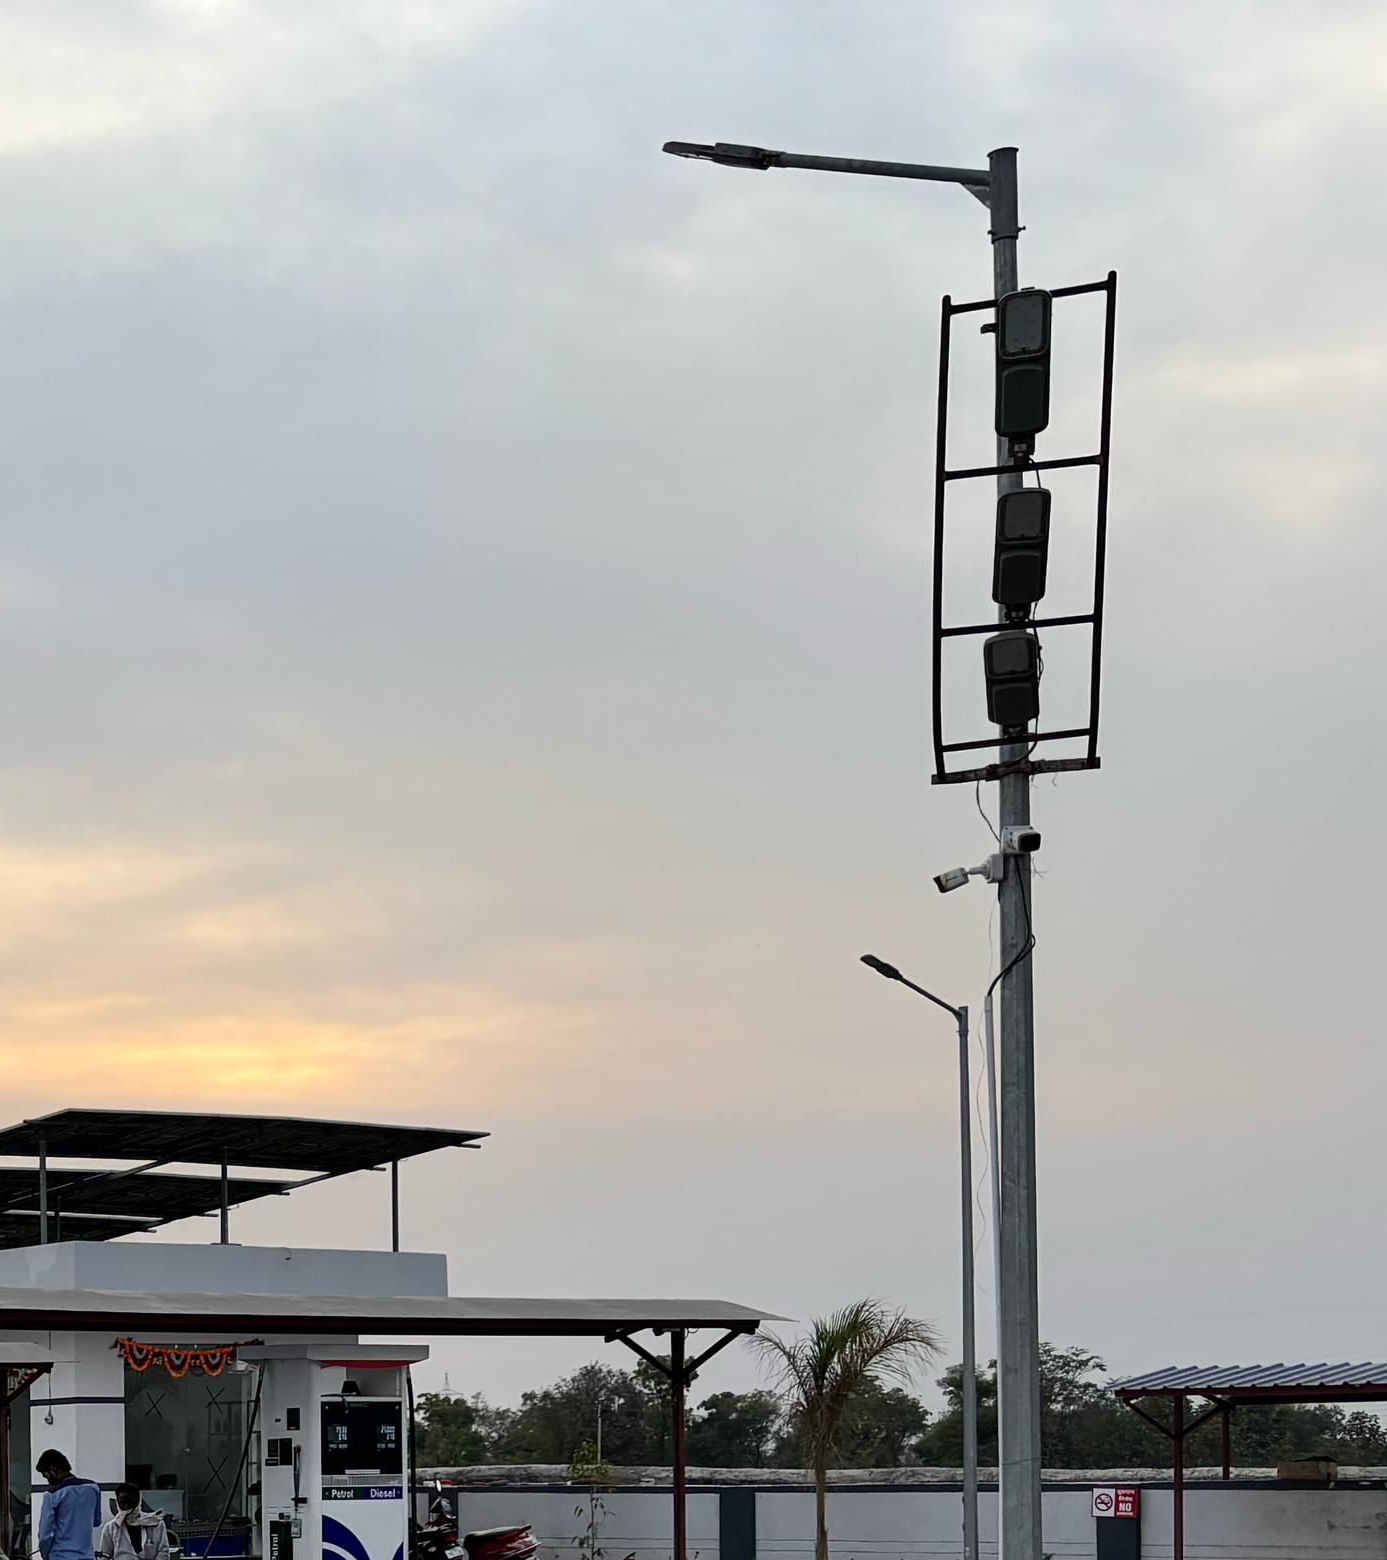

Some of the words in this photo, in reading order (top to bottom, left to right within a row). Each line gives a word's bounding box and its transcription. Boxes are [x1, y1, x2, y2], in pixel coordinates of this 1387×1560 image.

[331, 1489, 354, 1498] Petrol
[370, 1488, 396, 1498] Diesel
[1119, 1502, 1132, 1512] NO
